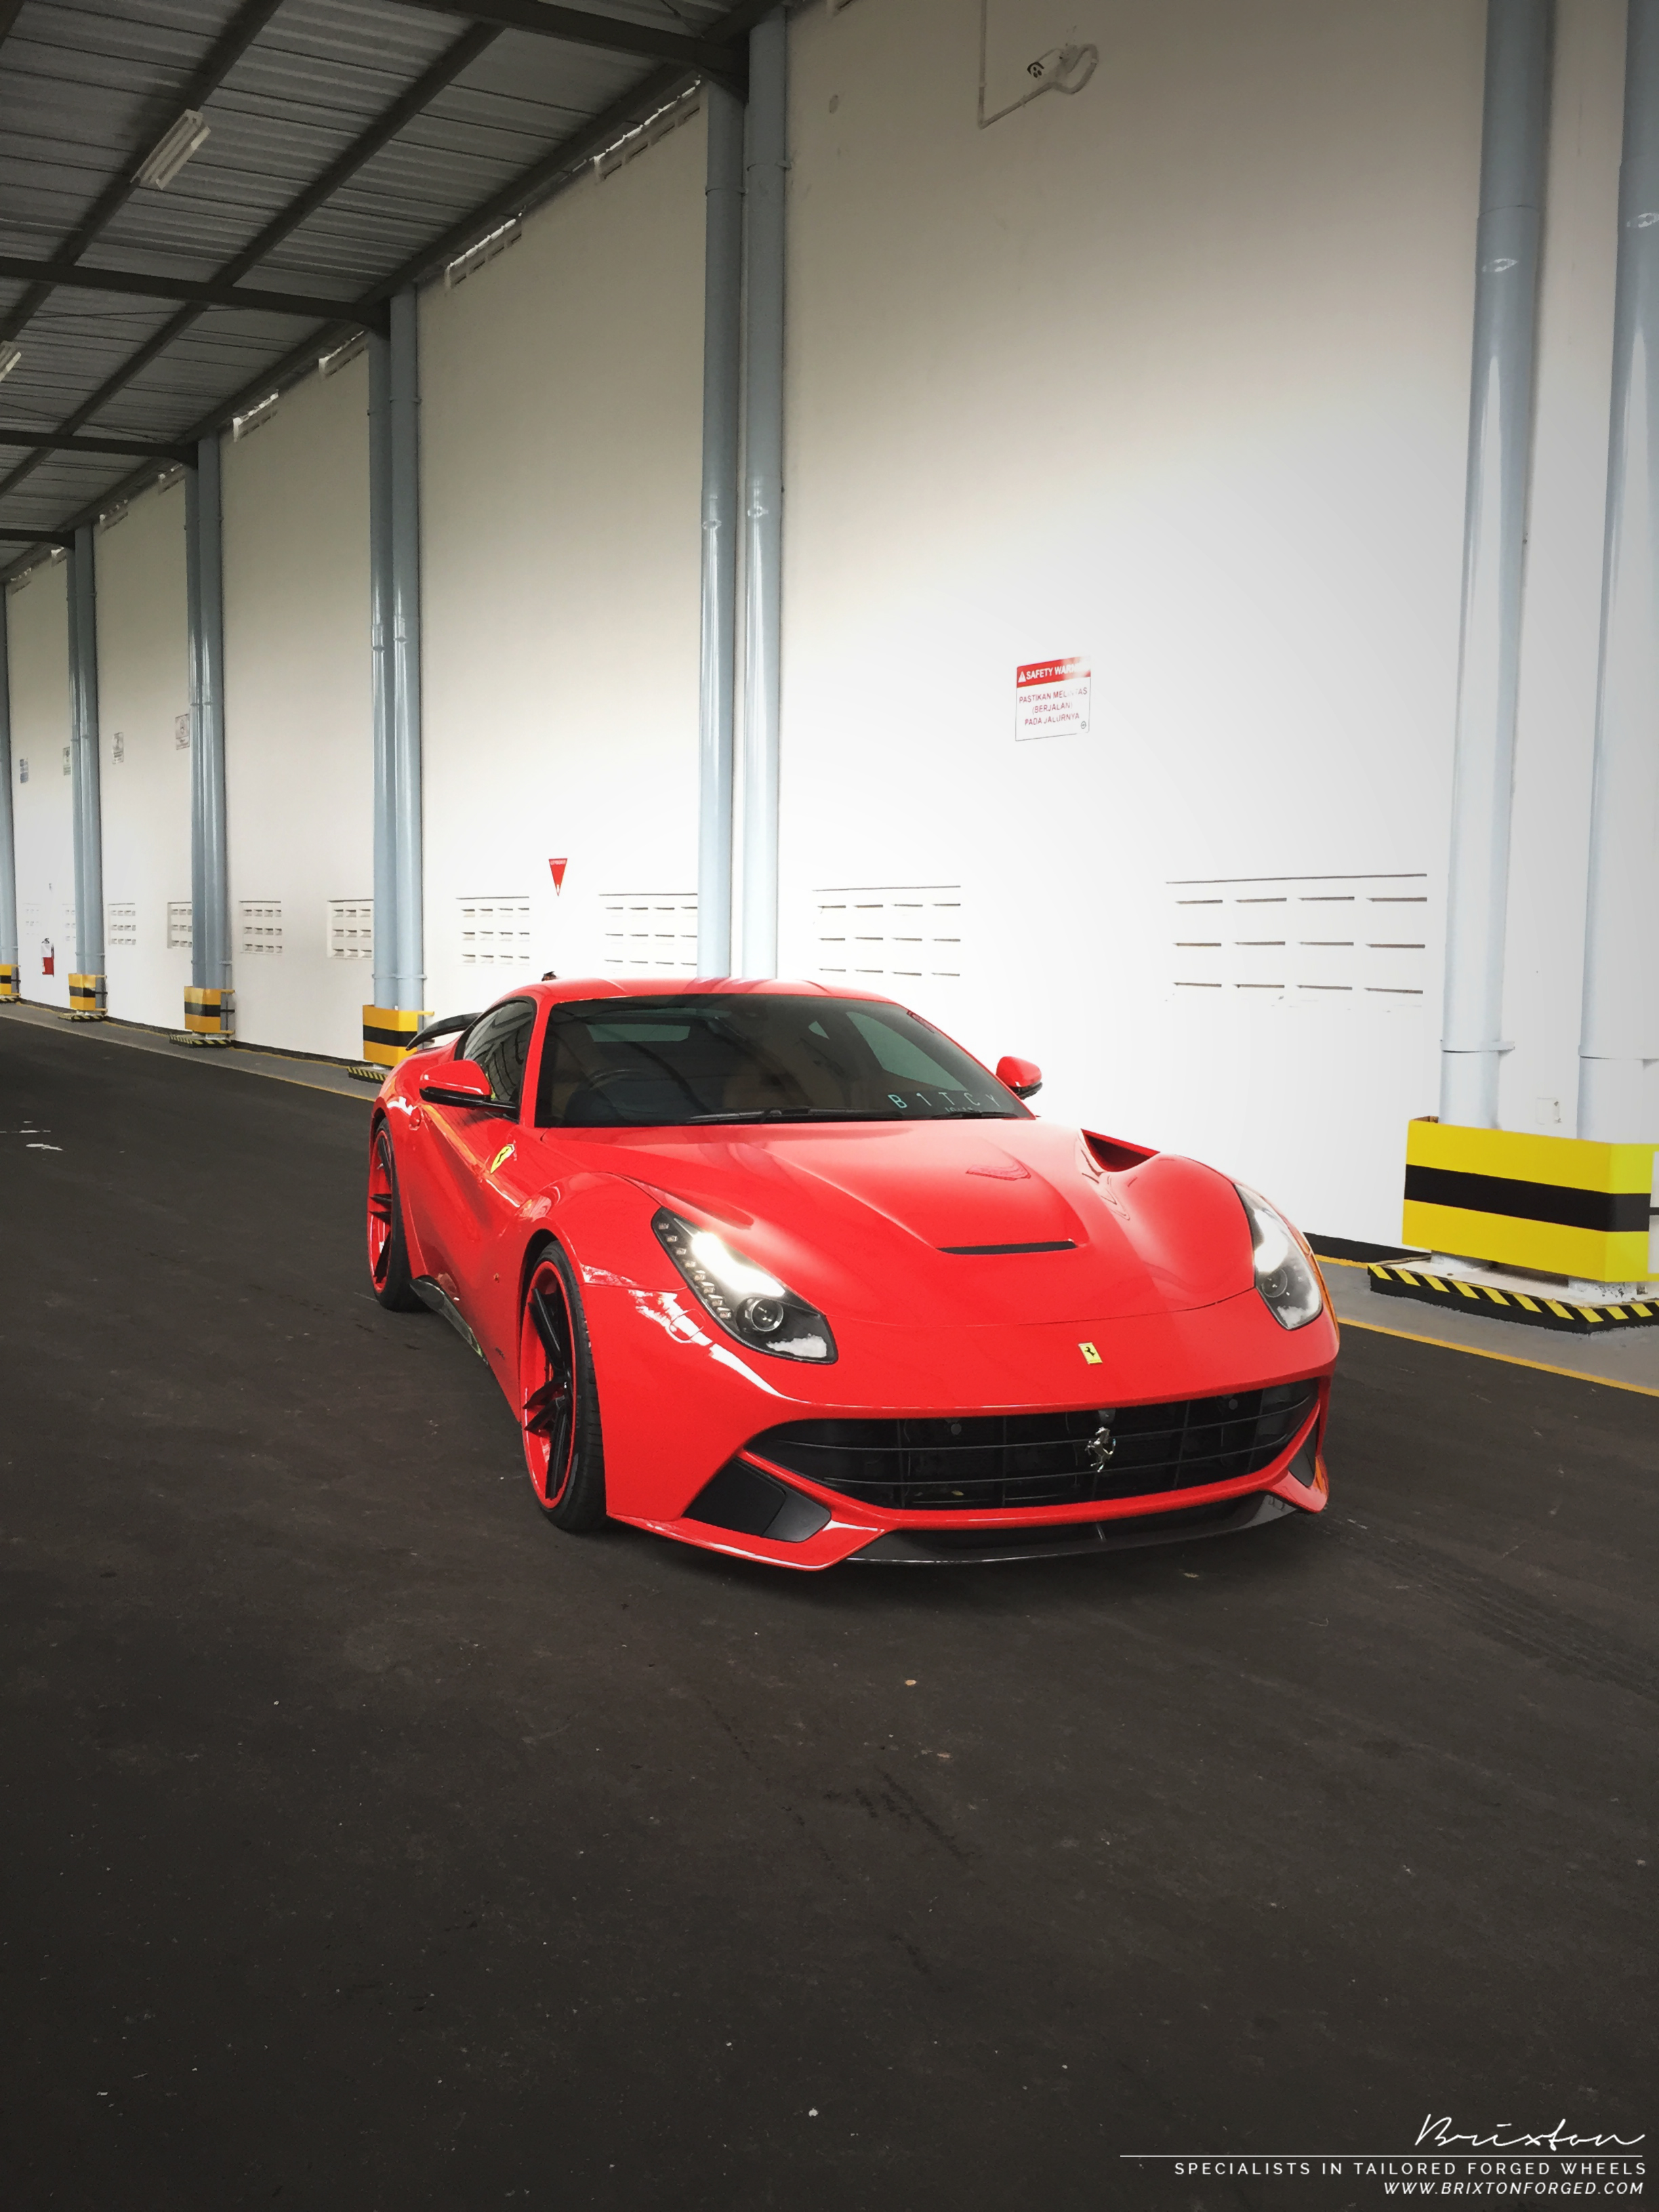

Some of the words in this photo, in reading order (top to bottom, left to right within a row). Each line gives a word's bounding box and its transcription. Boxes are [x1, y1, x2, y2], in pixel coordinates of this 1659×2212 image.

[1026, 668, 1053, 680] SAFETY
[1019, 693, 1051, 703] PASTIKAN
[1053, 687, 1088, 699] MELTAS
[1025, 718, 1042, 726] PADA
[1044, 712, 1080, 724] JALURNYA
